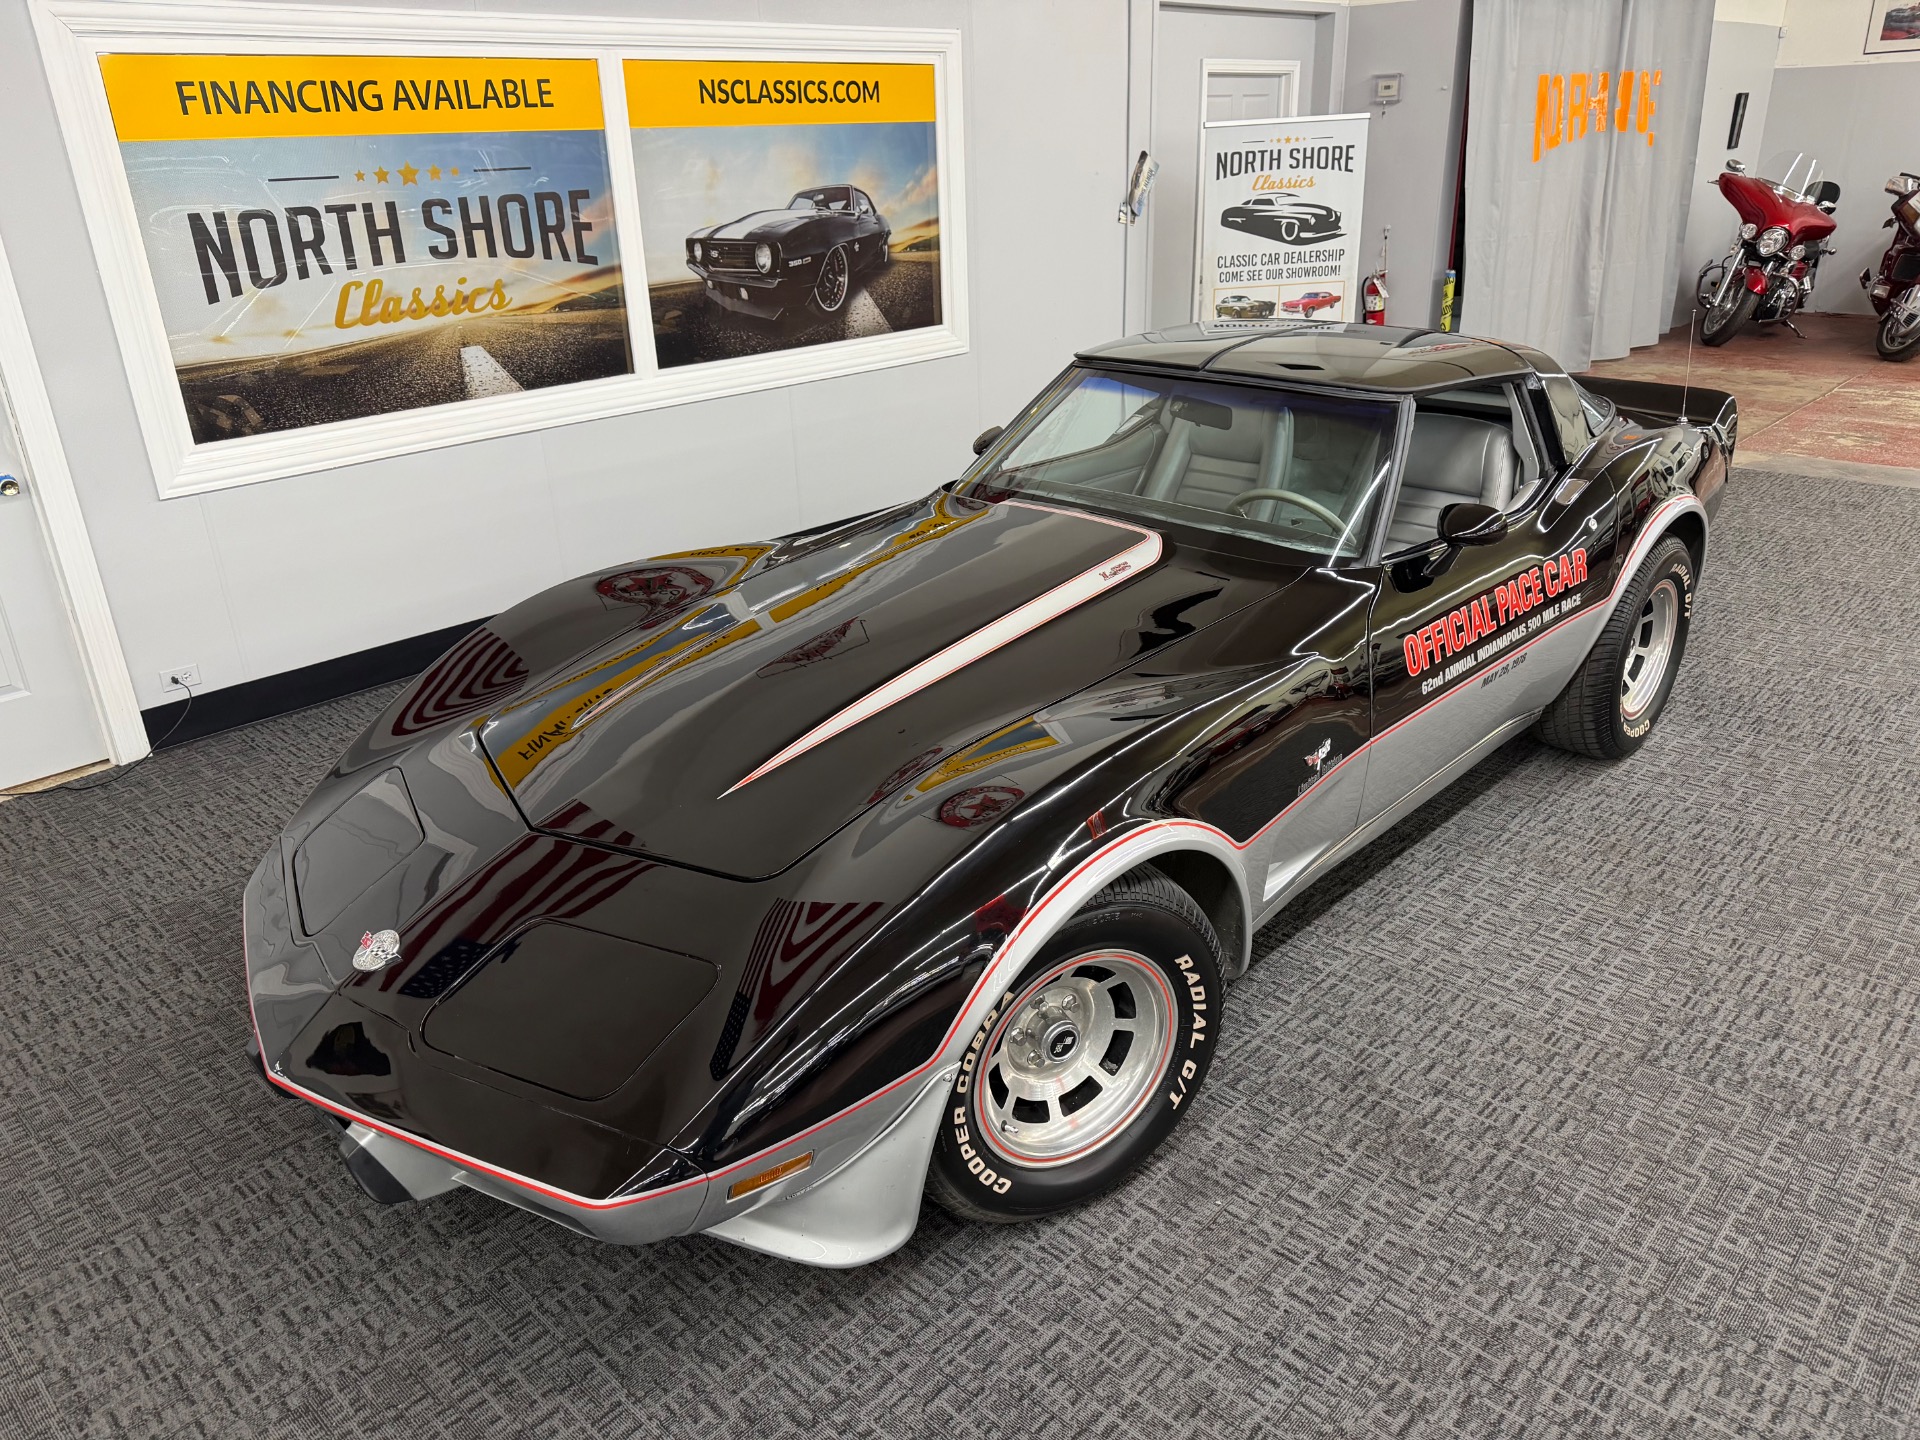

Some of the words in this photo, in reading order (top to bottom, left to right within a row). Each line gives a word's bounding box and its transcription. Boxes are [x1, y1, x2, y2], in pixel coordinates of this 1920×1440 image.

[175, 78, 384, 115] FINANCING
[393, 77, 555, 111] AVAILABLE
[698, 78, 881, 105] NSCLASSICS.COM
[1216, 148, 1281, 181] NORTH
[1288, 144, 1355, 173] SHORE
[1251, 174, 1316, 191] Classics
[187, 200, 406, 305] NORTH
[422, 189, 599, 266] SHORE
[1217, 252, 1257, 269] CLASSIC
[1260, 252, 1281, 266] CAR
[1283, 249, 1345, 265] DEALERSHIP
[1219, 270, 1244, 283] COME
[1246, 268, 1262, 282] SEE
[1265, 267, 1284, 280] OUR
[1285, 264, 1341, 279] SHOWROOM!
[334, 277, 512, 329] Classics
[1670, 563, 1688, 591] RADIAL
[1403, 594, 1497, 677] OFFICIAL
[1494, 566, 1544, 626] PACE
[1542, 547, 1588, 597] CAR
[1421, 671, 1444, 695] 62nd
[1444, 653, 1477, 683] ANNUAL
[1477, 625, 1527, 663] INDIANAPOLIS
[1527, 614, 1542, 632] 500
[1542, 605, 1560, 624] MILE
[1561, 593, 1581, 614] RACE
[1623, 718, 1650, 738] COOPER
[1174, 953, 1207, 1049] RADIAL
[956, 991, 1015, 1094] COBRA
[1169, 1059, 1197, 1110] G/T
[954, 1106, 1012, 1194] COOPER
